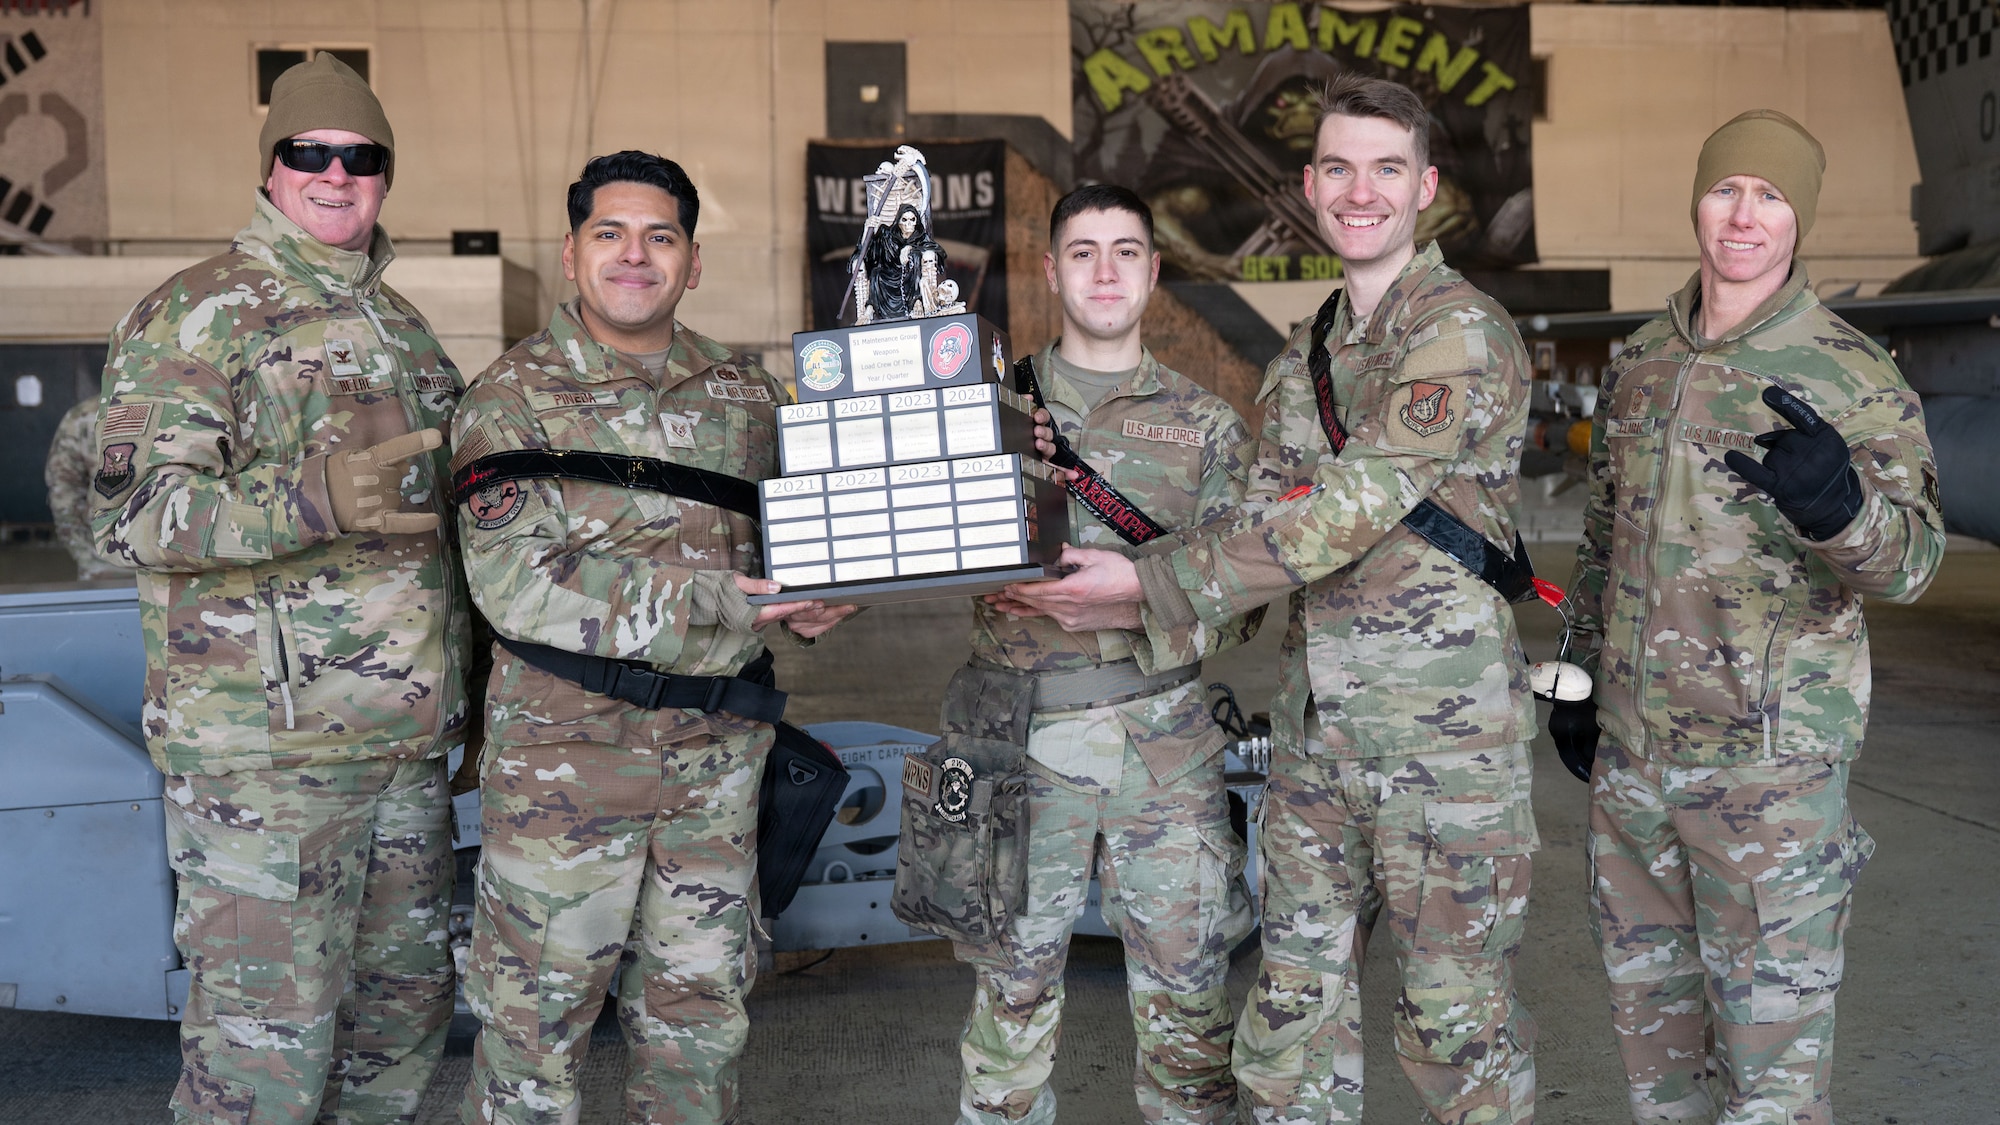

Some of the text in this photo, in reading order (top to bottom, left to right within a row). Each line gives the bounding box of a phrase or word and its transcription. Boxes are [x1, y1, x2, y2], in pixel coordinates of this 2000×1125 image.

[1083, 3, 1516, 113] ARMAMENT
[814, 171, 995, 217] WEONS
[1243, 255, 1290, 280] GET
[862, 335, 898, 345] Maintenance
[900, 332, 918, 343] Group
[873, 348, 899, 357] Weapons
[877, 361, 892, 369] Crew
[893, 359, 902, 367] Of
[902, 358, 914, 366] The
[1293, 362, 1311, 377] GIES
[867, 374, 881, 382] Year
[886, 371, 909, 380] Quarter
[553, 392, 597, 405] PINEDA
[726, 386, 740, 398] AIR
[741, 387, 768, 400] FORCE
[895, 393, 931, 408] 2023
[949, 387, 985, 402] 2024
[788, 405, 822, 420] 2021
[841, 399, 877, 414] 2022
[1127, 422, 1201, 444] U.S. AIR FORCE
[1705, 430, 1721, 444] AIR
[1723, 432, 1755, 449] FORCE
[898, 465, 942, 480] 2023
[961, 458, 1005, 474] 2024
[773, 479, 815, 494] 2021
[834, 472, 879, 487] 2022
[841, 746, 928, 763] EIGHT CAPACIT
[951, 759, 968, 771] 2W1
[904, 760, 929, 791] WPNS
